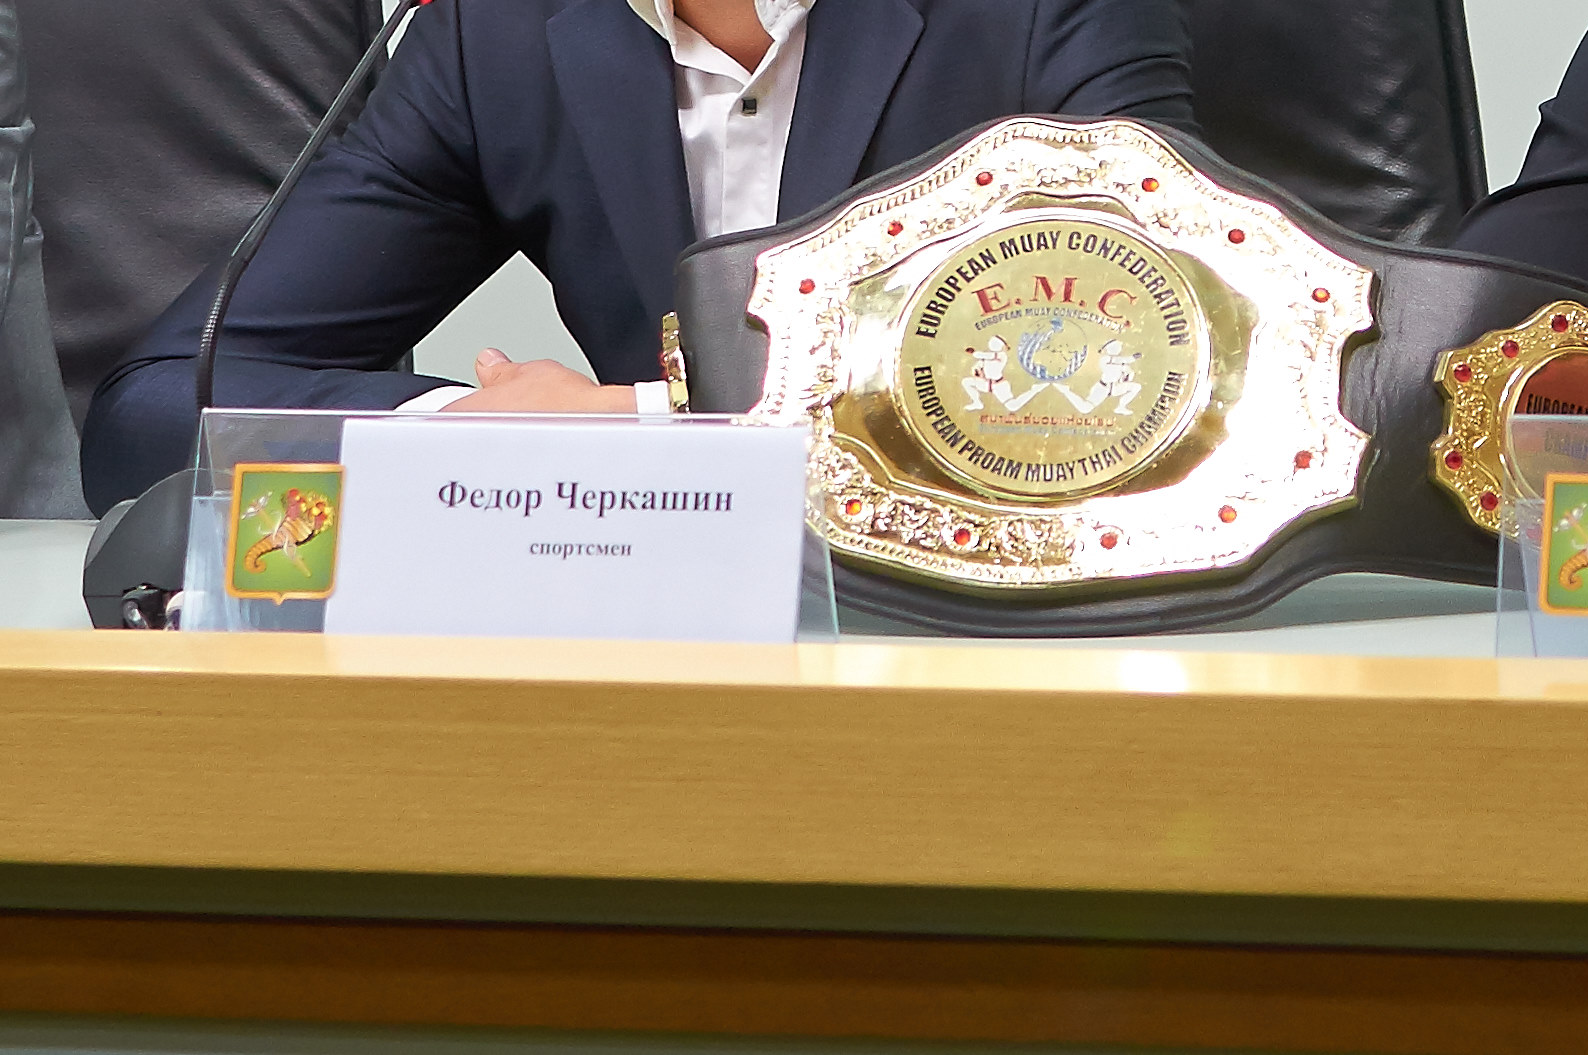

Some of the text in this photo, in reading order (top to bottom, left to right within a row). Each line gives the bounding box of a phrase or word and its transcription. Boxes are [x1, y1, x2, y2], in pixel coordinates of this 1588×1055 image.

[915, 230, 1191, 346] EUROPEAN MUAY CONFEDERATION
[913, 365, 966, 448] EUROPEAN
[958, 439, 1021, 480] PROAM
[1120, 370, 1189, 454] CHAMPION
[438, 481, 734, 519] Федор Черкашин
[529, 541, 633, 560] спортсмен
